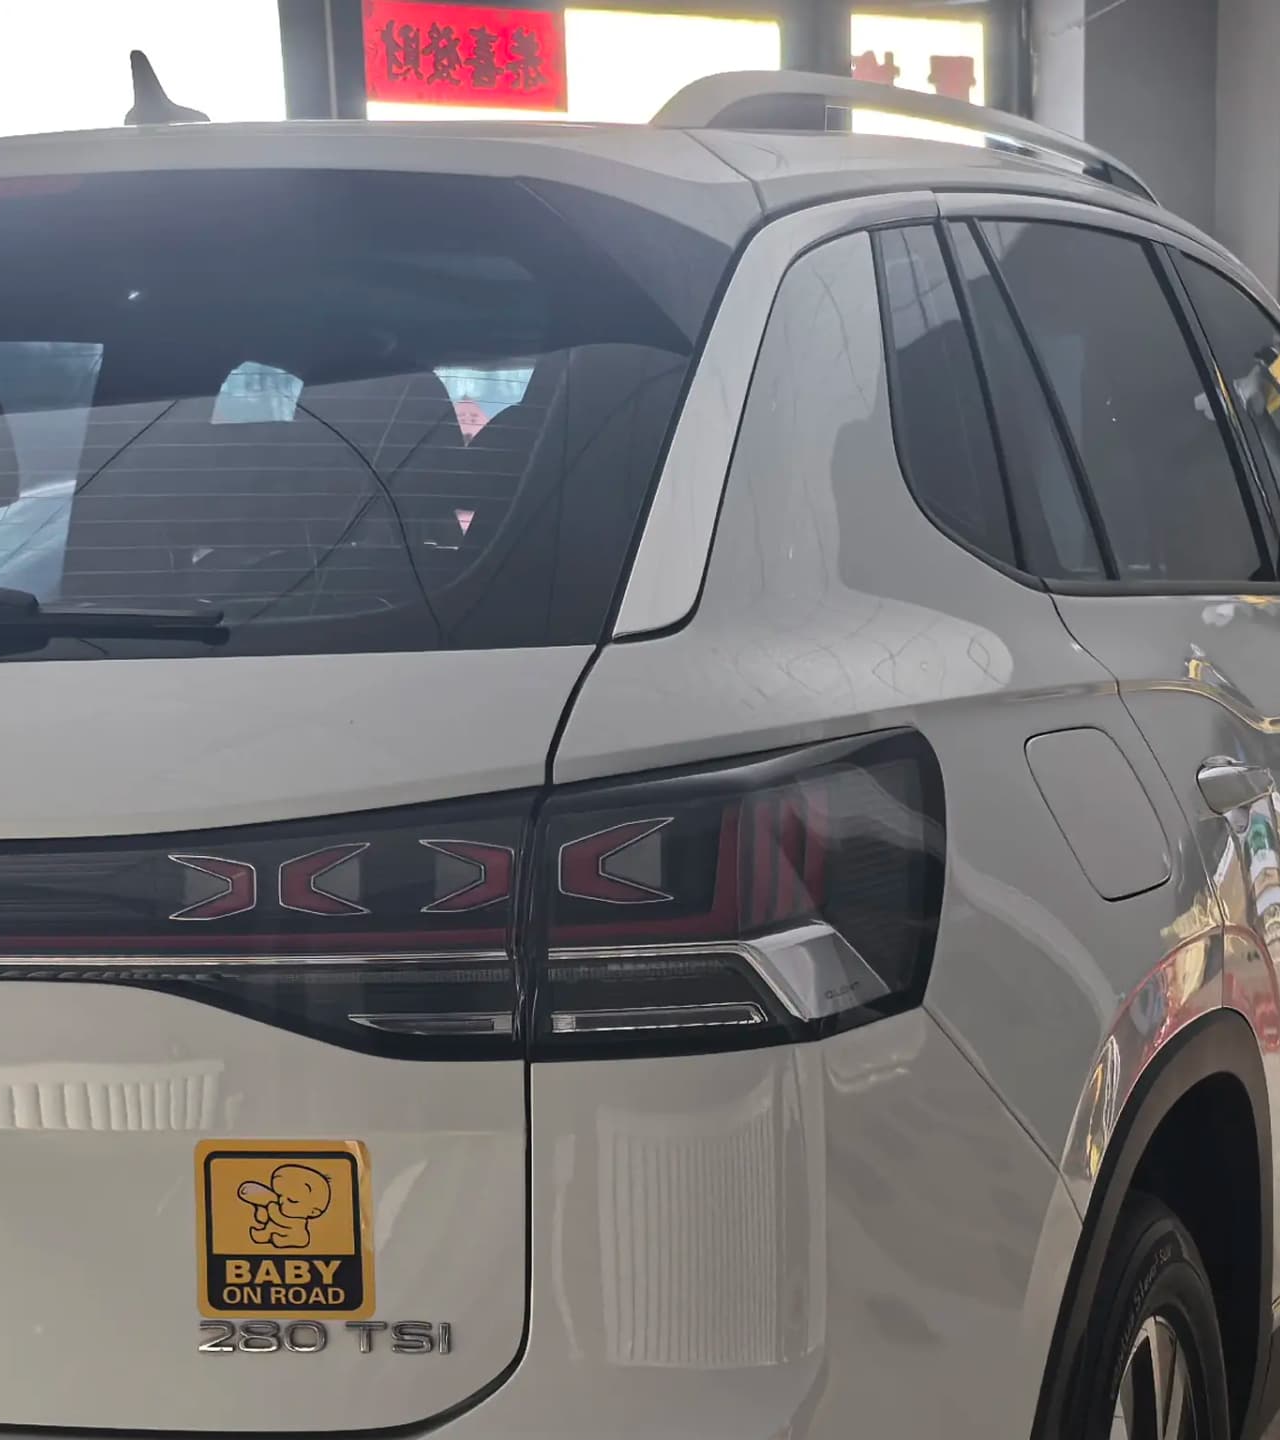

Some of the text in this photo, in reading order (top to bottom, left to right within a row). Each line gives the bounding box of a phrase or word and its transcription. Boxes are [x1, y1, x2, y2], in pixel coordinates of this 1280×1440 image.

[225, 1259, 342, 1285] BABY
[222, 1286, 346, 1305] ON ROAD
[198, 1319, 452, 1353] 280 TSI
